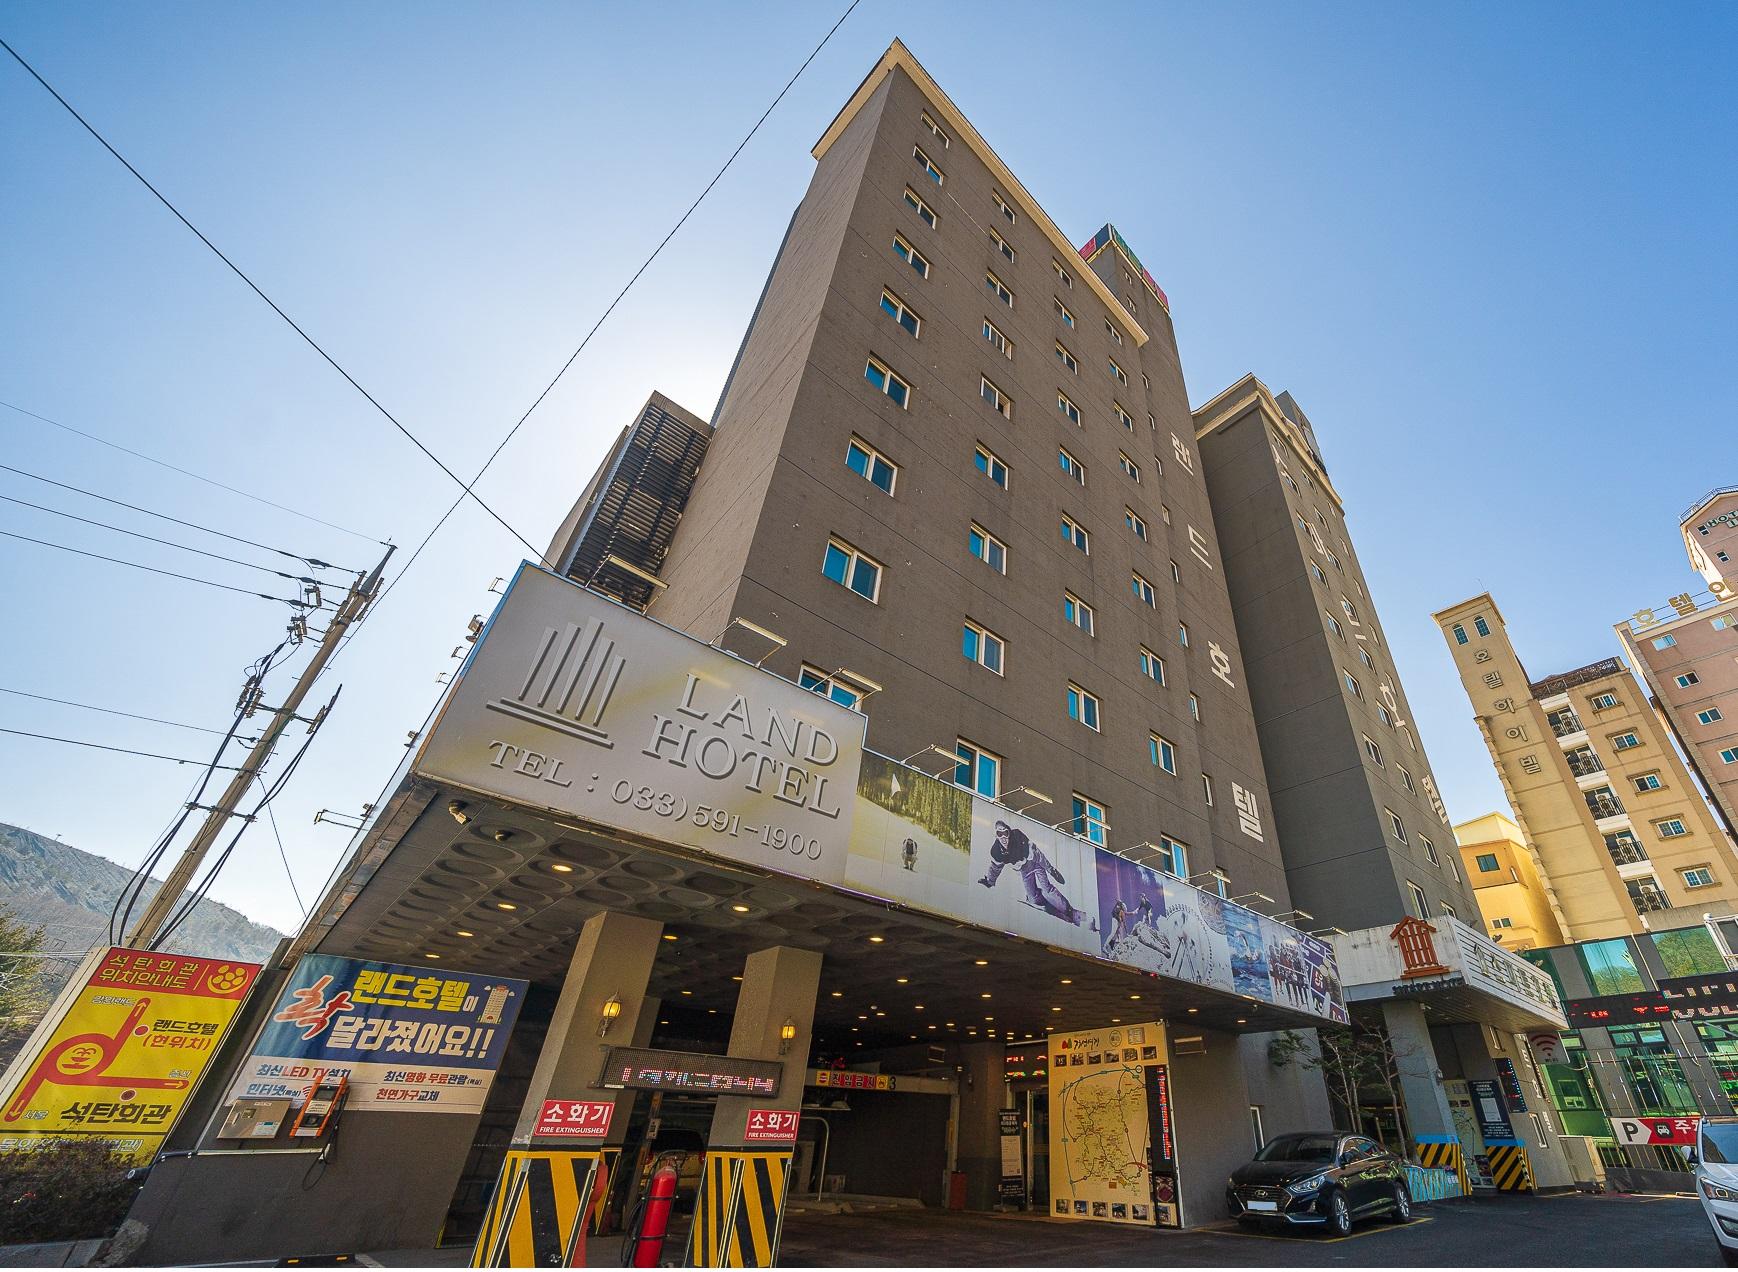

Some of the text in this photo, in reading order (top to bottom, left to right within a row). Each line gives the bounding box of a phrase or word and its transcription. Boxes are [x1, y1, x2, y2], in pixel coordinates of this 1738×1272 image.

[1170, 431, 1264, 843] 랜드호텔
[676, 672, 841, 767] LAND
[642, 714, 841, 819] HOTEL
[488, 740, 572, 787] TEL
[610, 777, 823, 861] 033)591-1900
[98, 967, 190, 990] 위치안내도
[350, 969, 480, 1013] 랜드호텔이
[152, 1019, 220, 1036] 랜드호텔
[325, 1015, 495, 1059] 달라졌어요!!
[142, 1033, 212, 1051] (현위치)
[60, 1101, 174, 1125] 석탄회관
[543, 1103, 610, 1125] 소화기
[750, 1112, 797, 1131] 소화기
[1621, 1121, 1639, 1142] P
